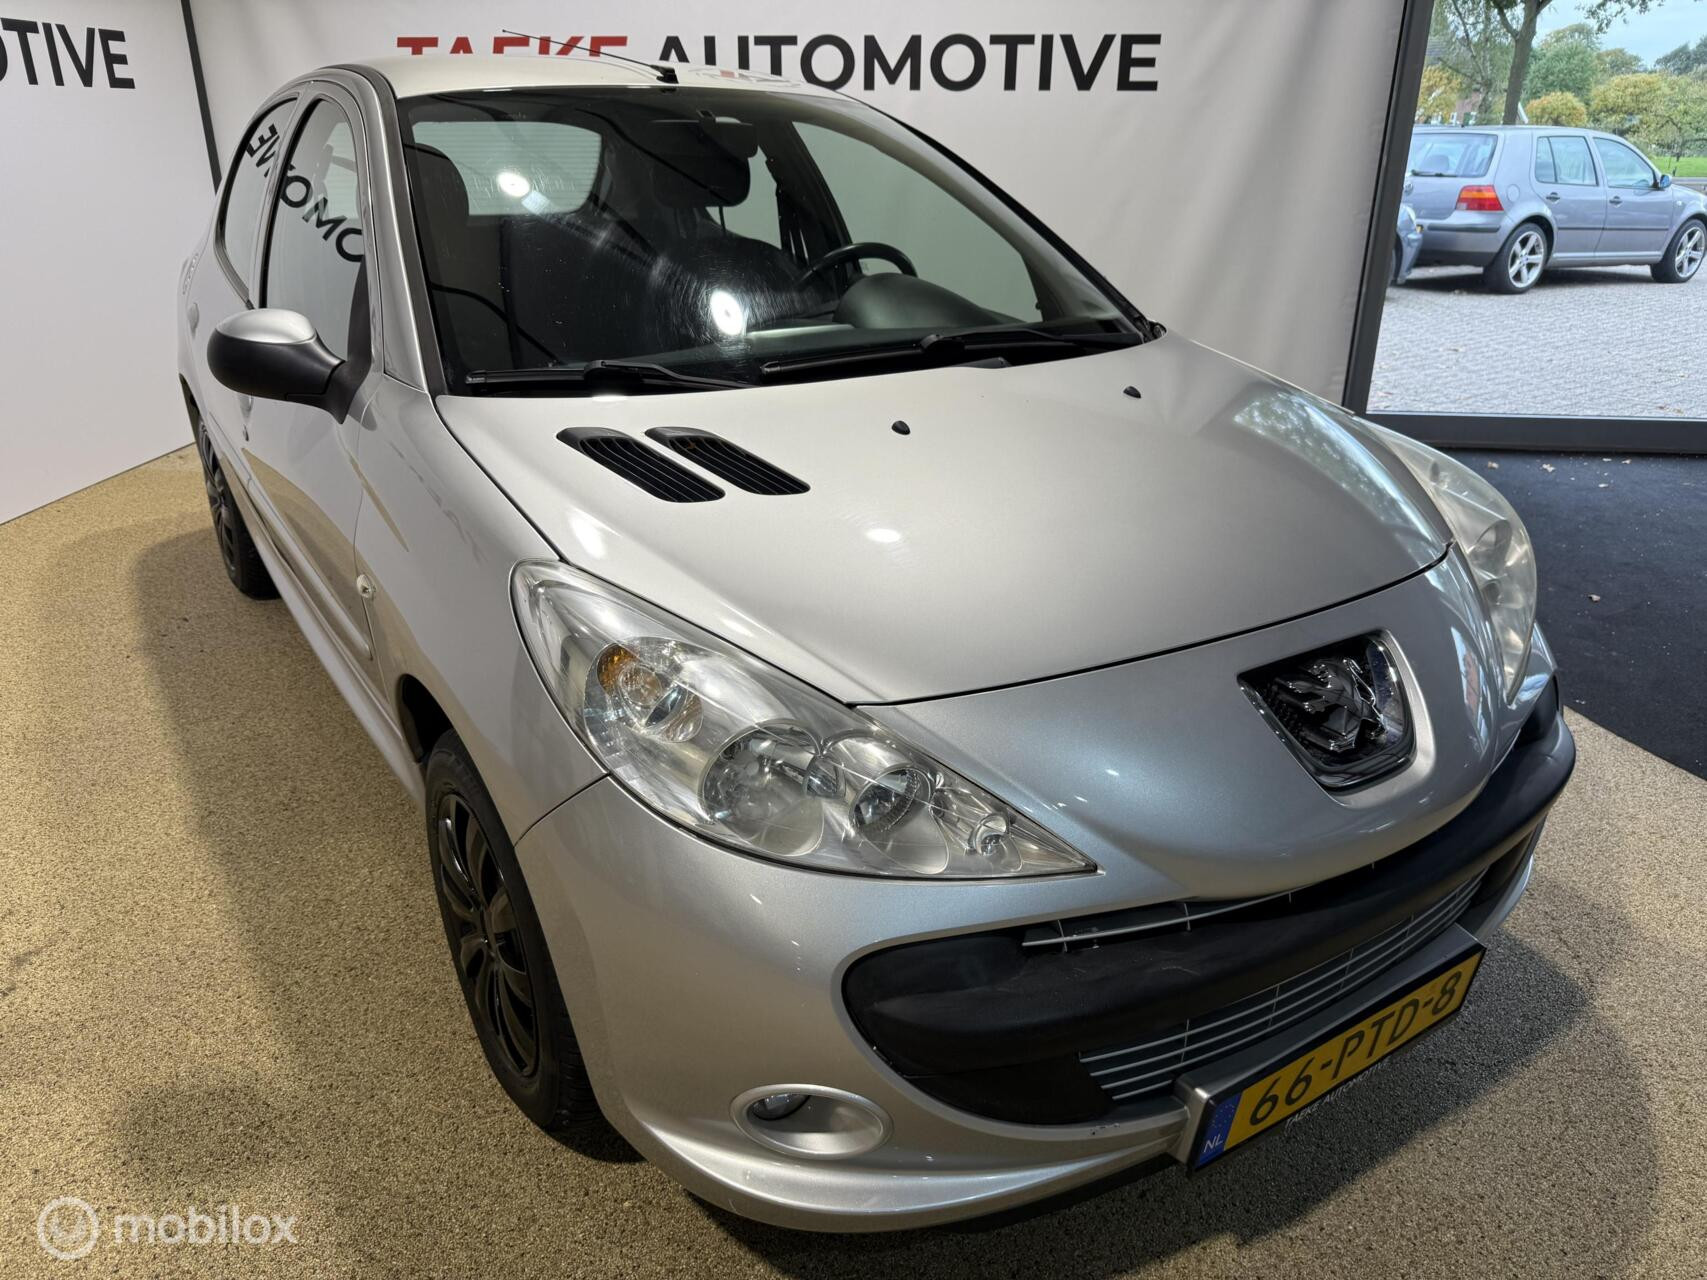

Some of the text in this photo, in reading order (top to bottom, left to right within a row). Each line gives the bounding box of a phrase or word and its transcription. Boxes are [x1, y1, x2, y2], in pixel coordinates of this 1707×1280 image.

[0, 17, 136, 89] TIVE
[1251, 971, 1462, 1126] 66-PTD-8
[1203, 1136, 1224, 1154] NL
